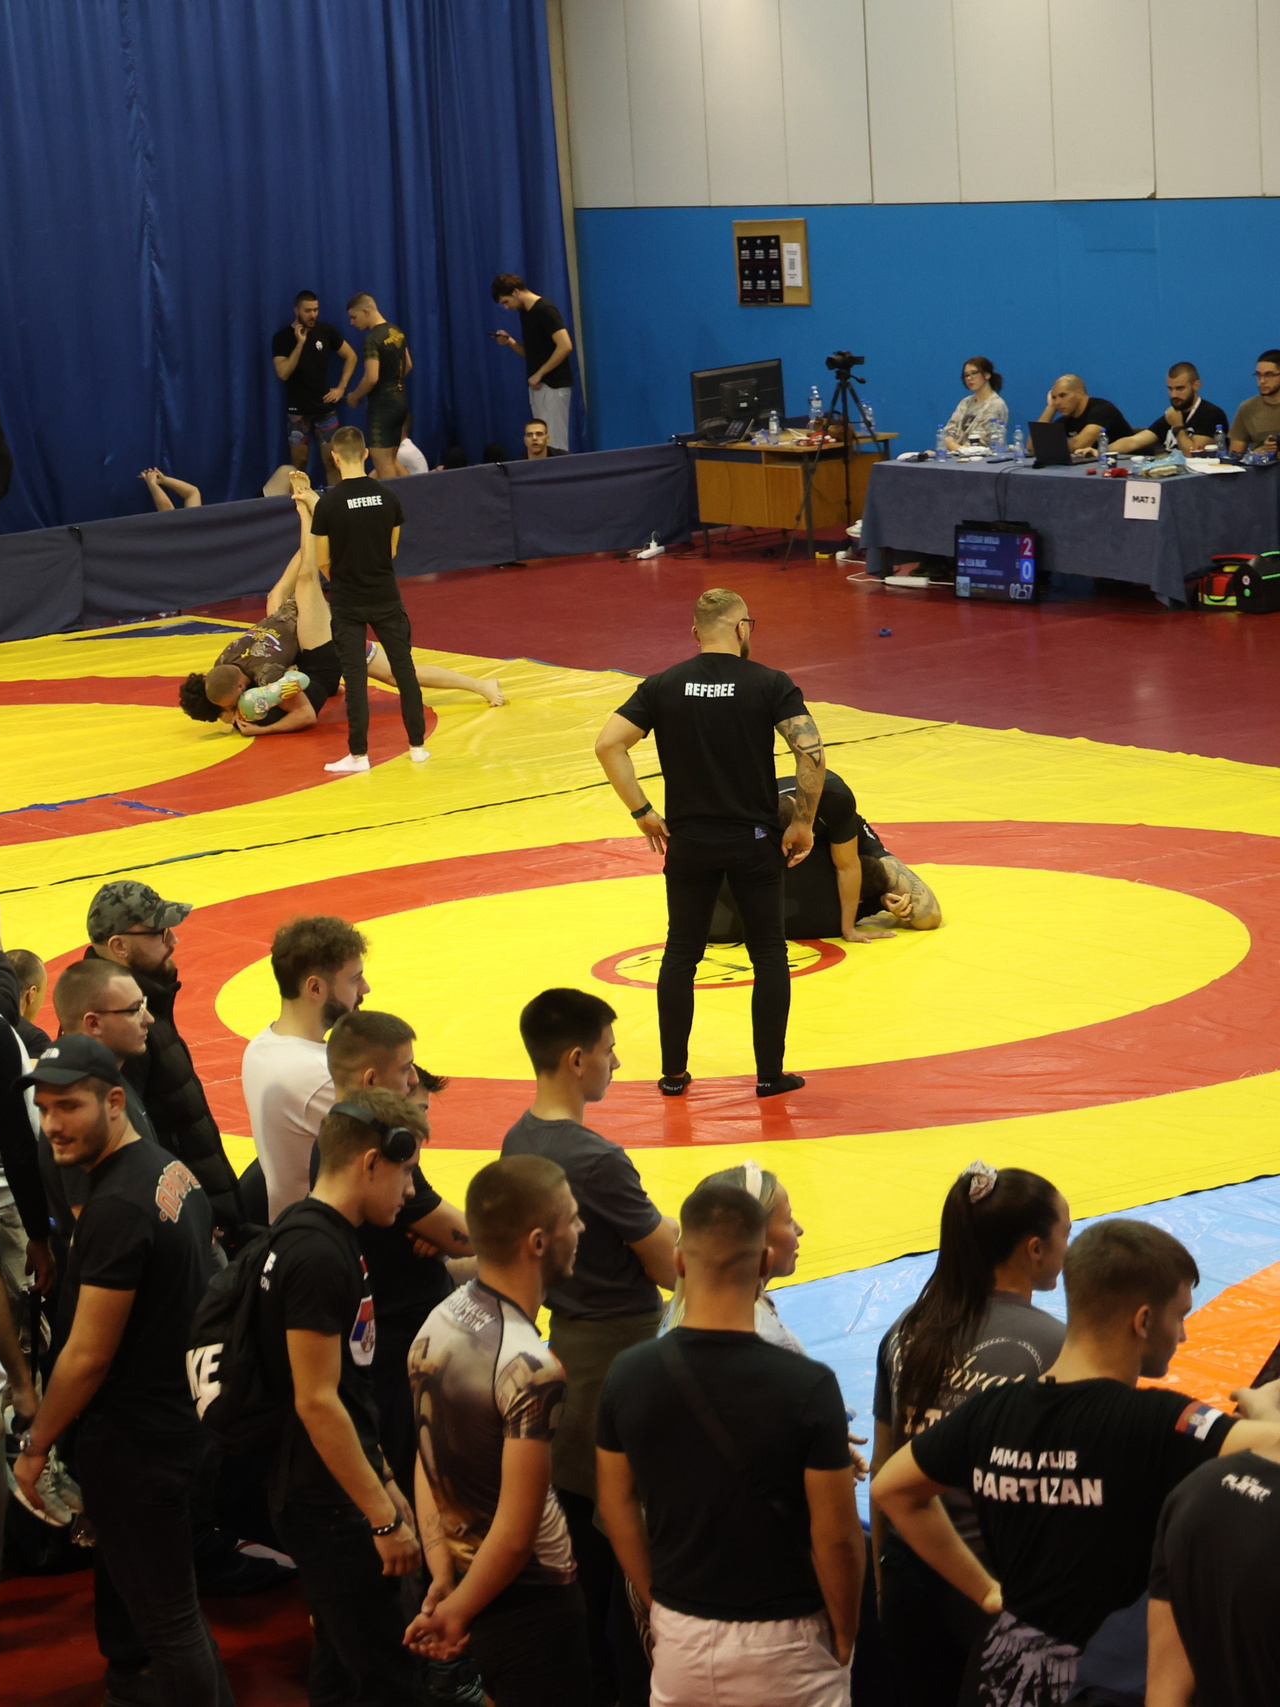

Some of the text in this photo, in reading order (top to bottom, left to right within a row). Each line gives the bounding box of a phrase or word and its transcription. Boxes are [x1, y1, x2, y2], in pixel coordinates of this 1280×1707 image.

[346, 495, 383, 509] REFEREE
[1132, 495, 1149, 503] MAT
[1022, 537, 1033, 556] 2
[1022, 561, 1032, 580] 0
[684, 682, 736, 698] REFEREE
[185, 1343, 224, 1401] KE
[989, 1446, 1078, 1471] MMA KLUB
[973, 1467, 1103, 1506] PARTIZAN
